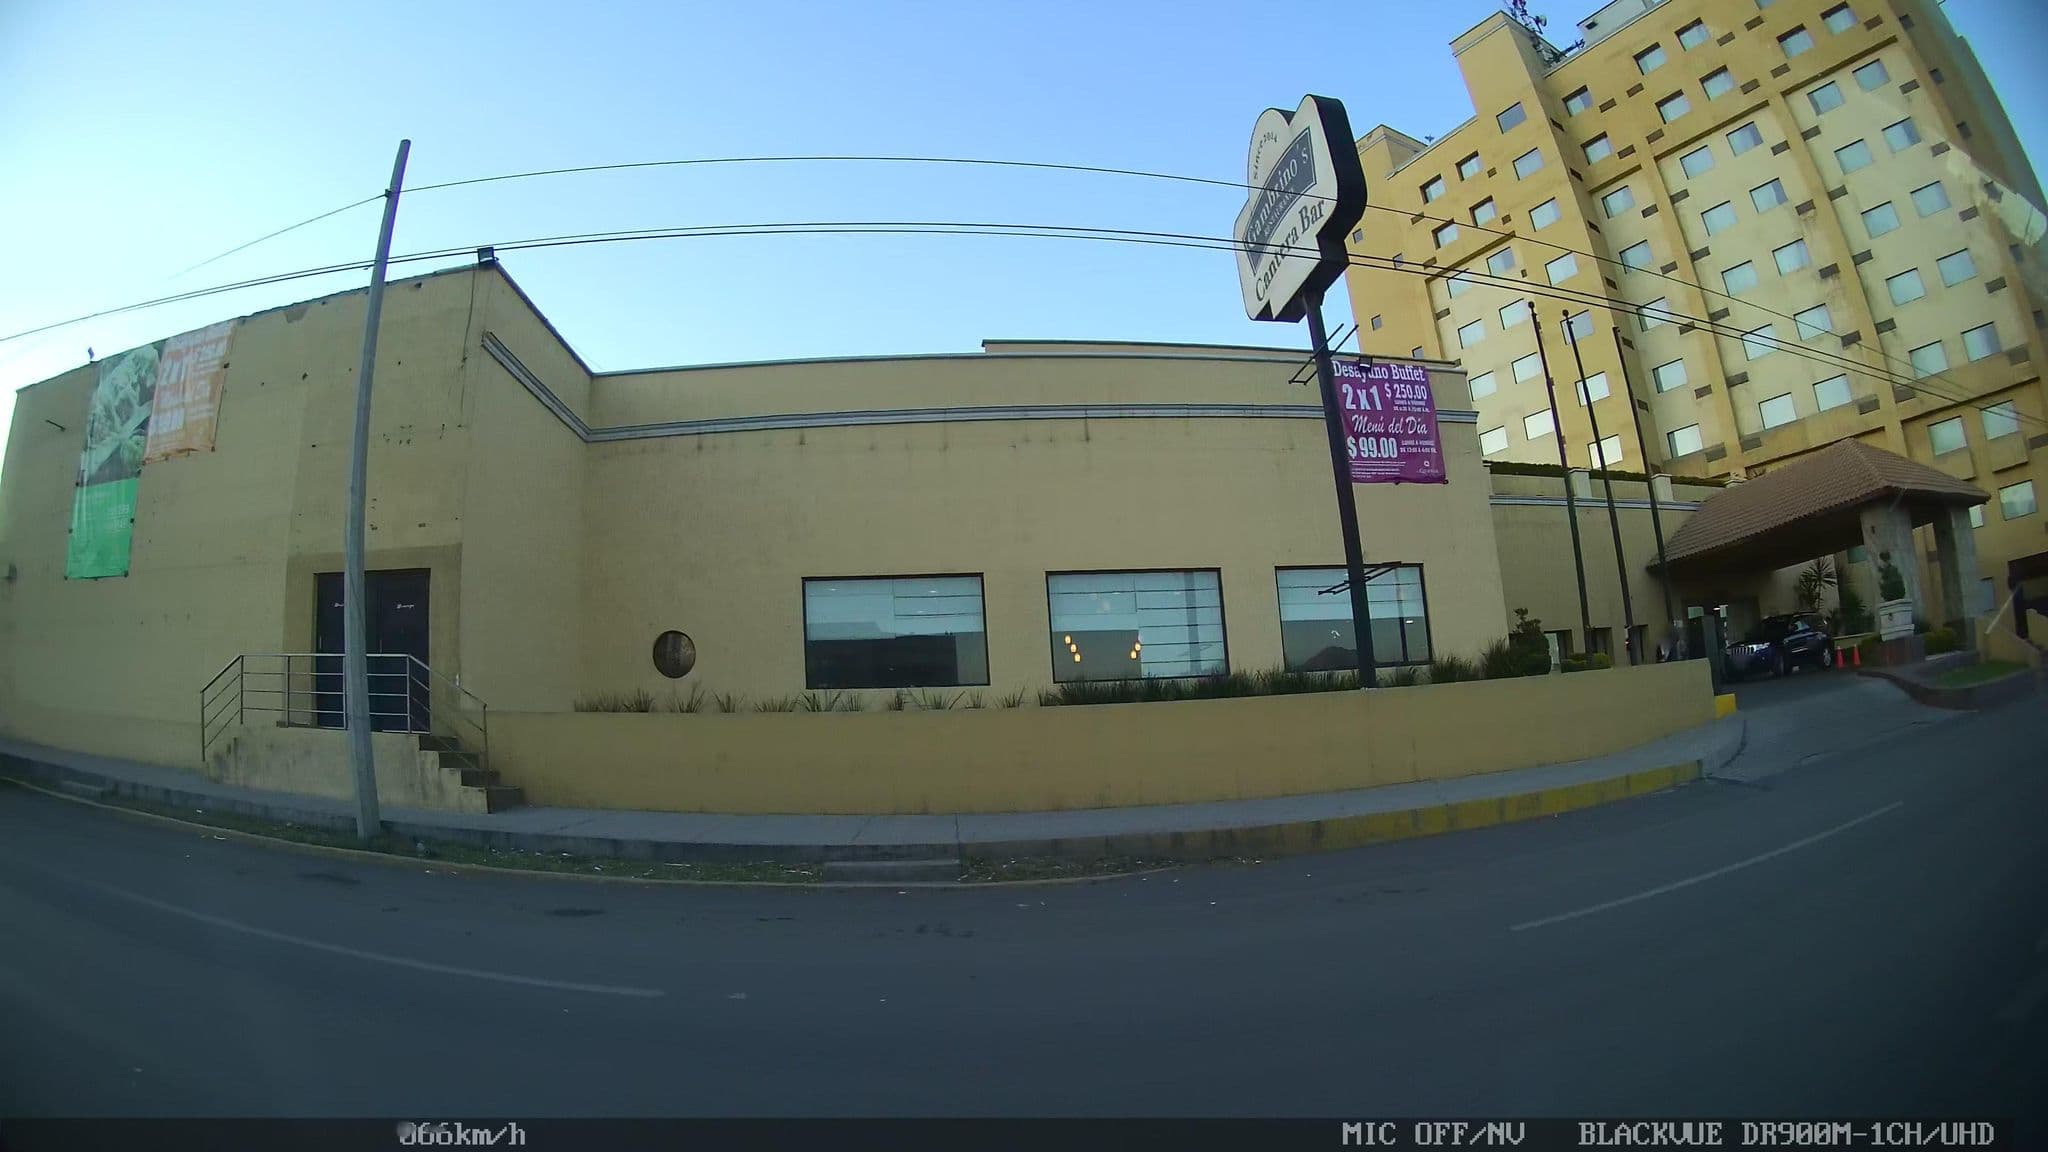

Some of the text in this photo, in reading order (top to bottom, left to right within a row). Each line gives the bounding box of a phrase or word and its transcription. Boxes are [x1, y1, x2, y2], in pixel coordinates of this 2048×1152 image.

[1255, 200, 1325, 302] Cantera Bar
[1390, 364, 1426, 382] Buffet
[1388, 416, 1404, 434] del
